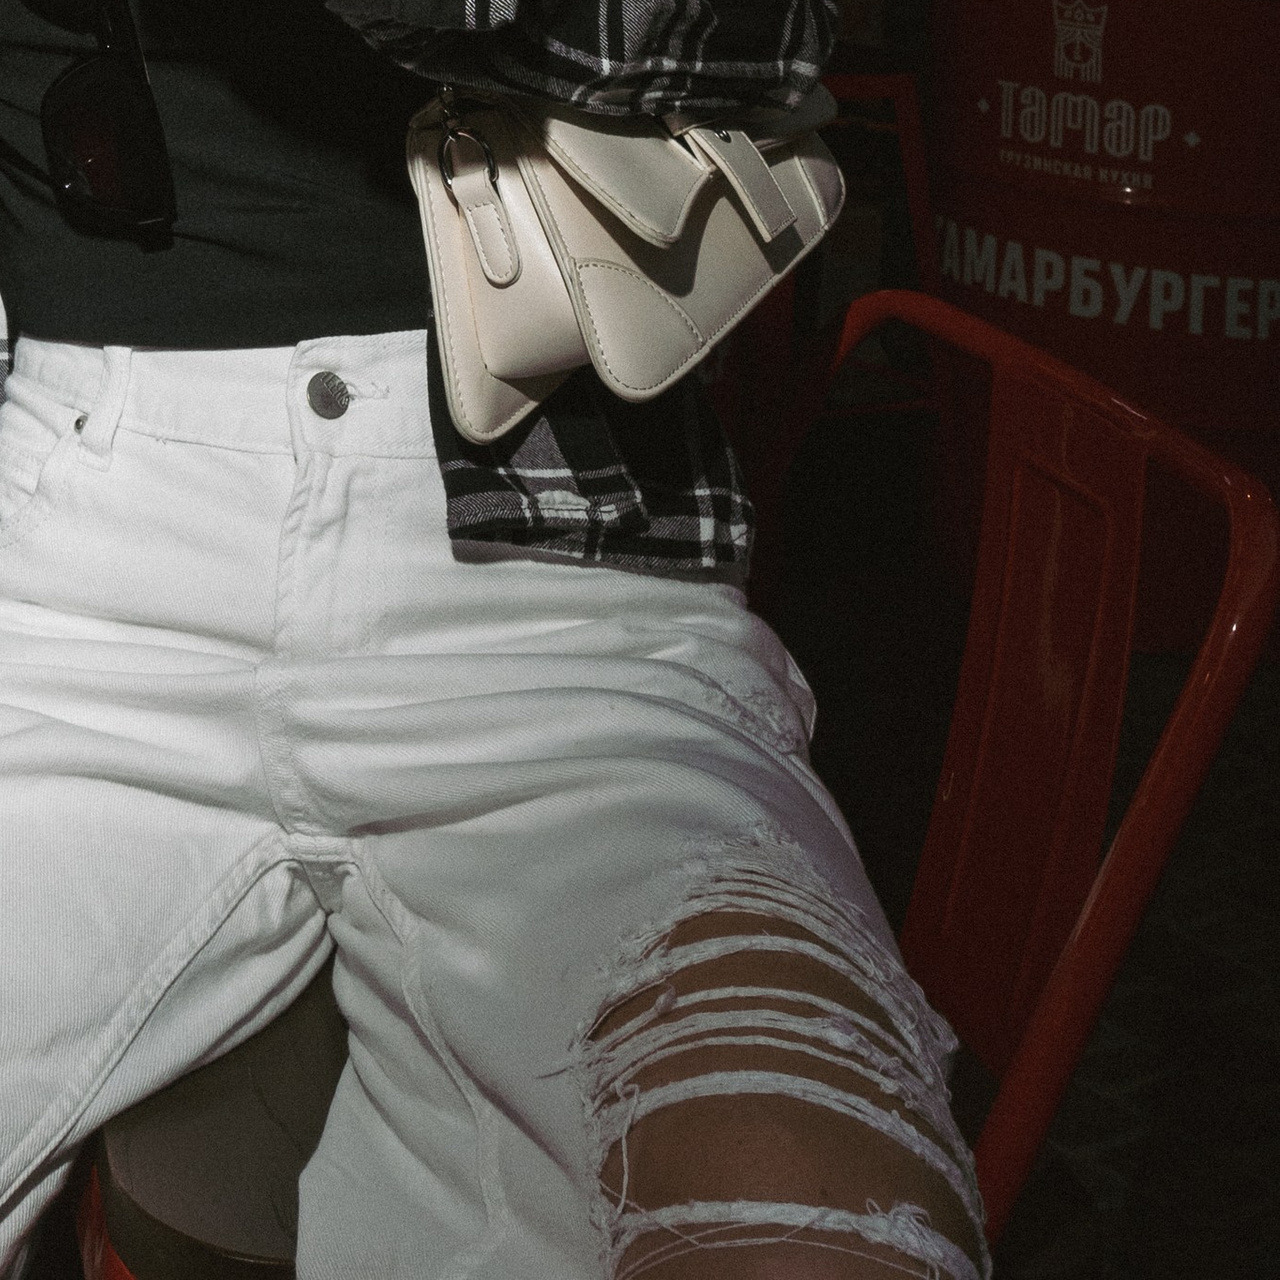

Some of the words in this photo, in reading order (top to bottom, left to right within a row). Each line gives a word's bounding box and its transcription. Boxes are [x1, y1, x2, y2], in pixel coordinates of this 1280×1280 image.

[998, 149, 1093, 181] ГРУЗИНСКАЯ
[1098, 167, 1154, 190] КУХНЯ
[933, 214, 1280, 340] АМАРБУРГЕР
